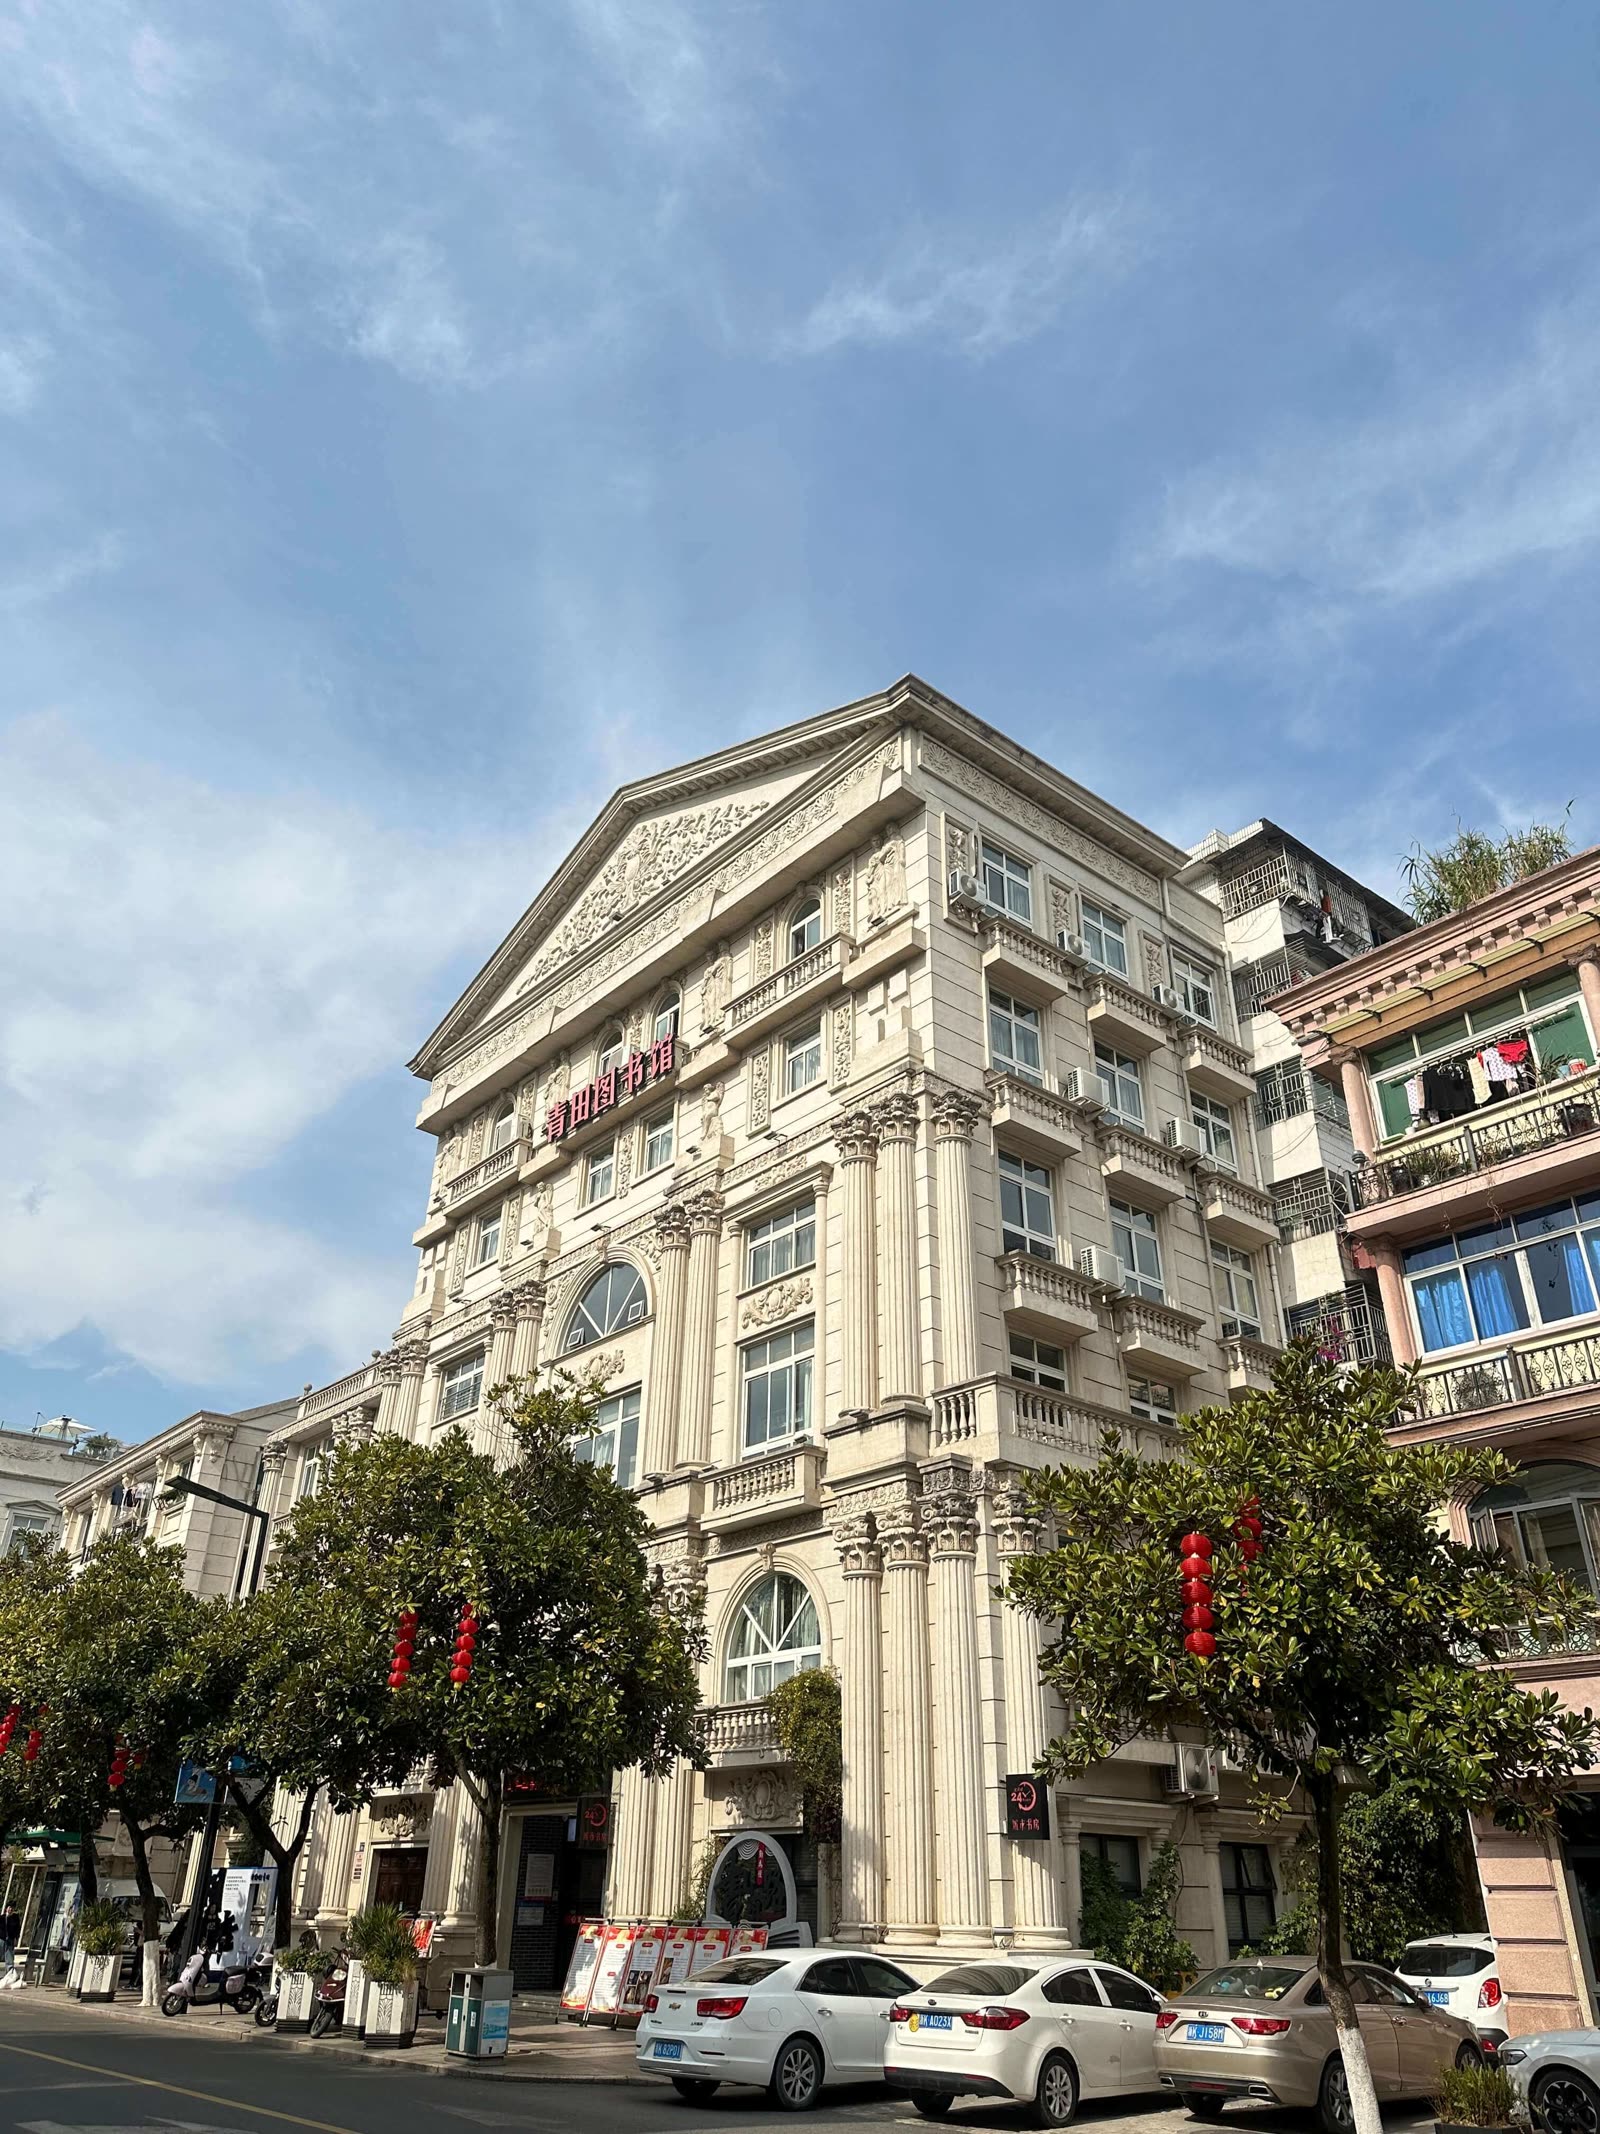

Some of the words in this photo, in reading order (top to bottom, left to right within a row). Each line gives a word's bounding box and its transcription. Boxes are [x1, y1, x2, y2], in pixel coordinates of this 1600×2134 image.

[546, 1033, 674, 1142] 青田图书馆
[1011, 1792, 1023, 1802] 24
